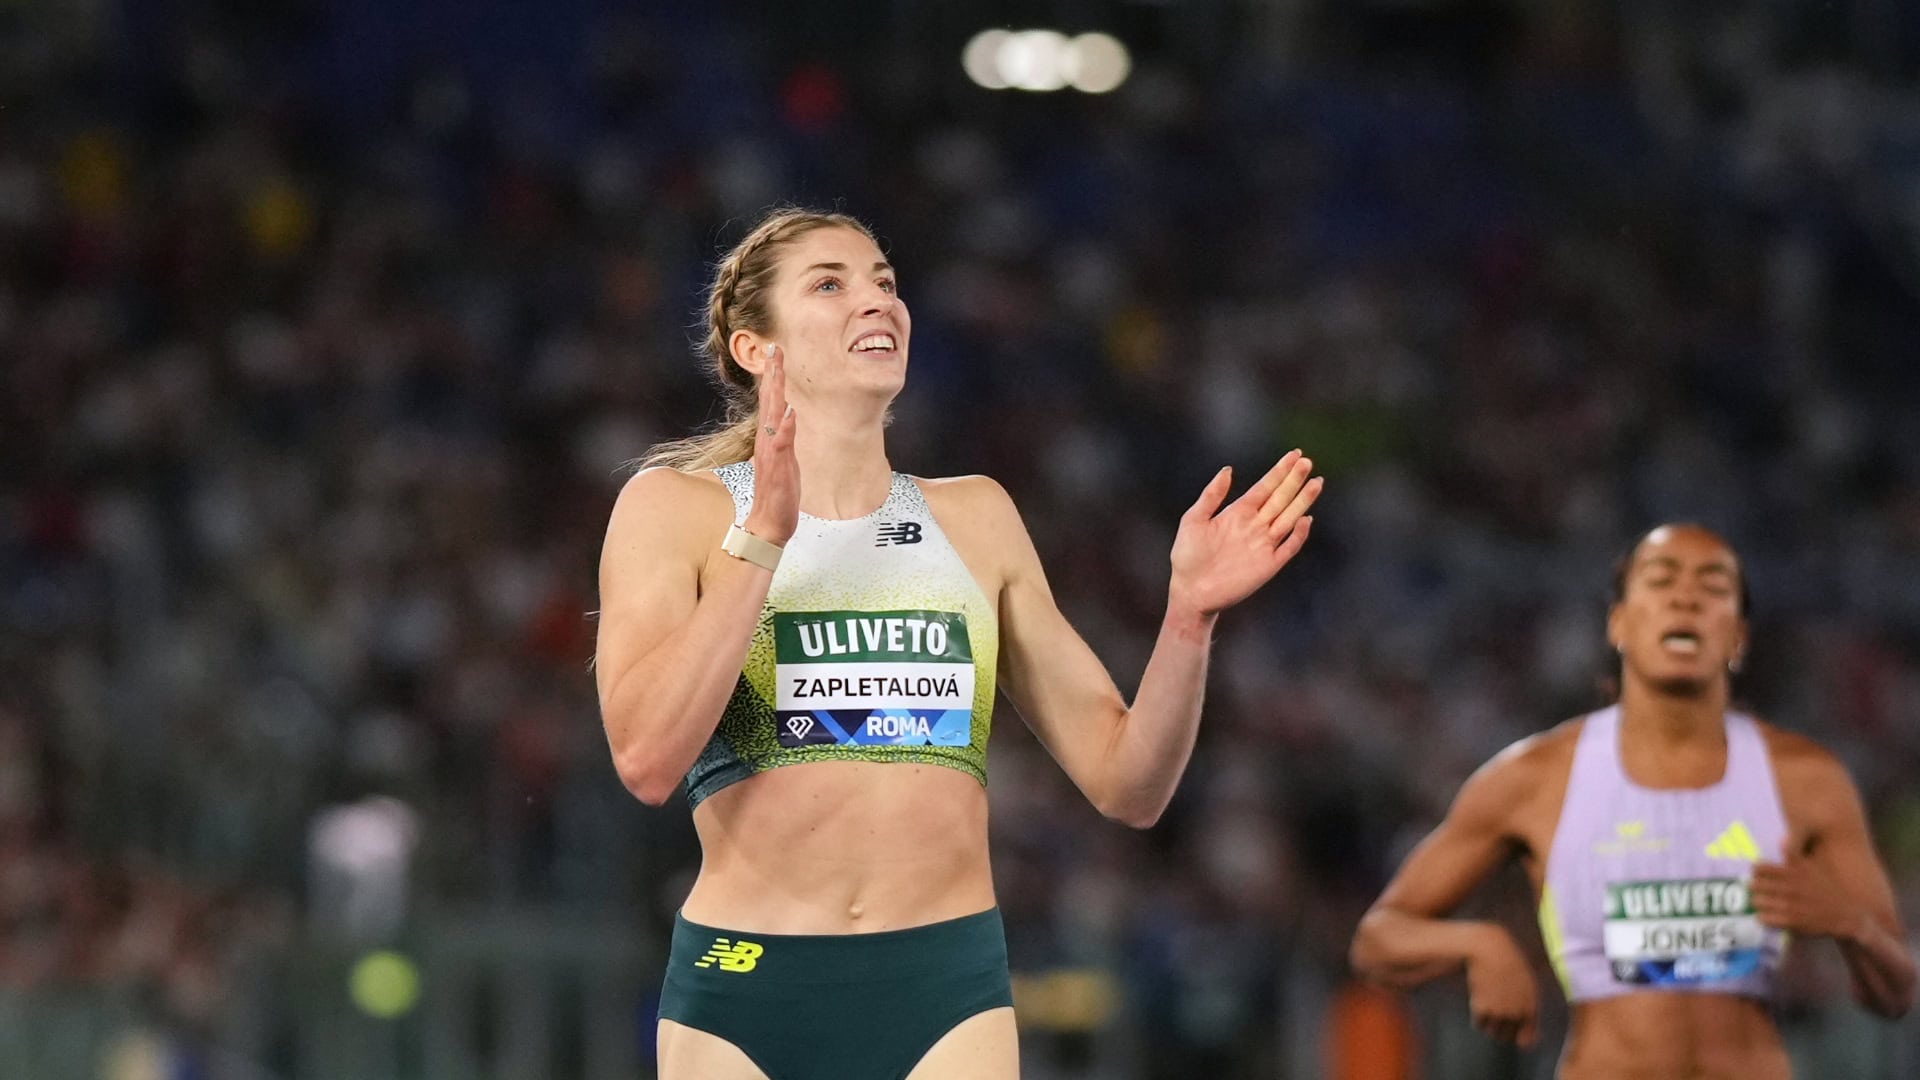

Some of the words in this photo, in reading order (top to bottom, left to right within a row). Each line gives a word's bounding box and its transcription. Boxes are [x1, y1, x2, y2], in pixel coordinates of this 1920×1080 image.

[798, 617, 947, 658] ULIVETO
[793, 673, 960, 698] ZAPLETALOVÁ
[866, 716, 931, 737] ROMA
[1622, 883, 1748, 918] ULIVETO
[1640, 922, 1736, 951] JONES
